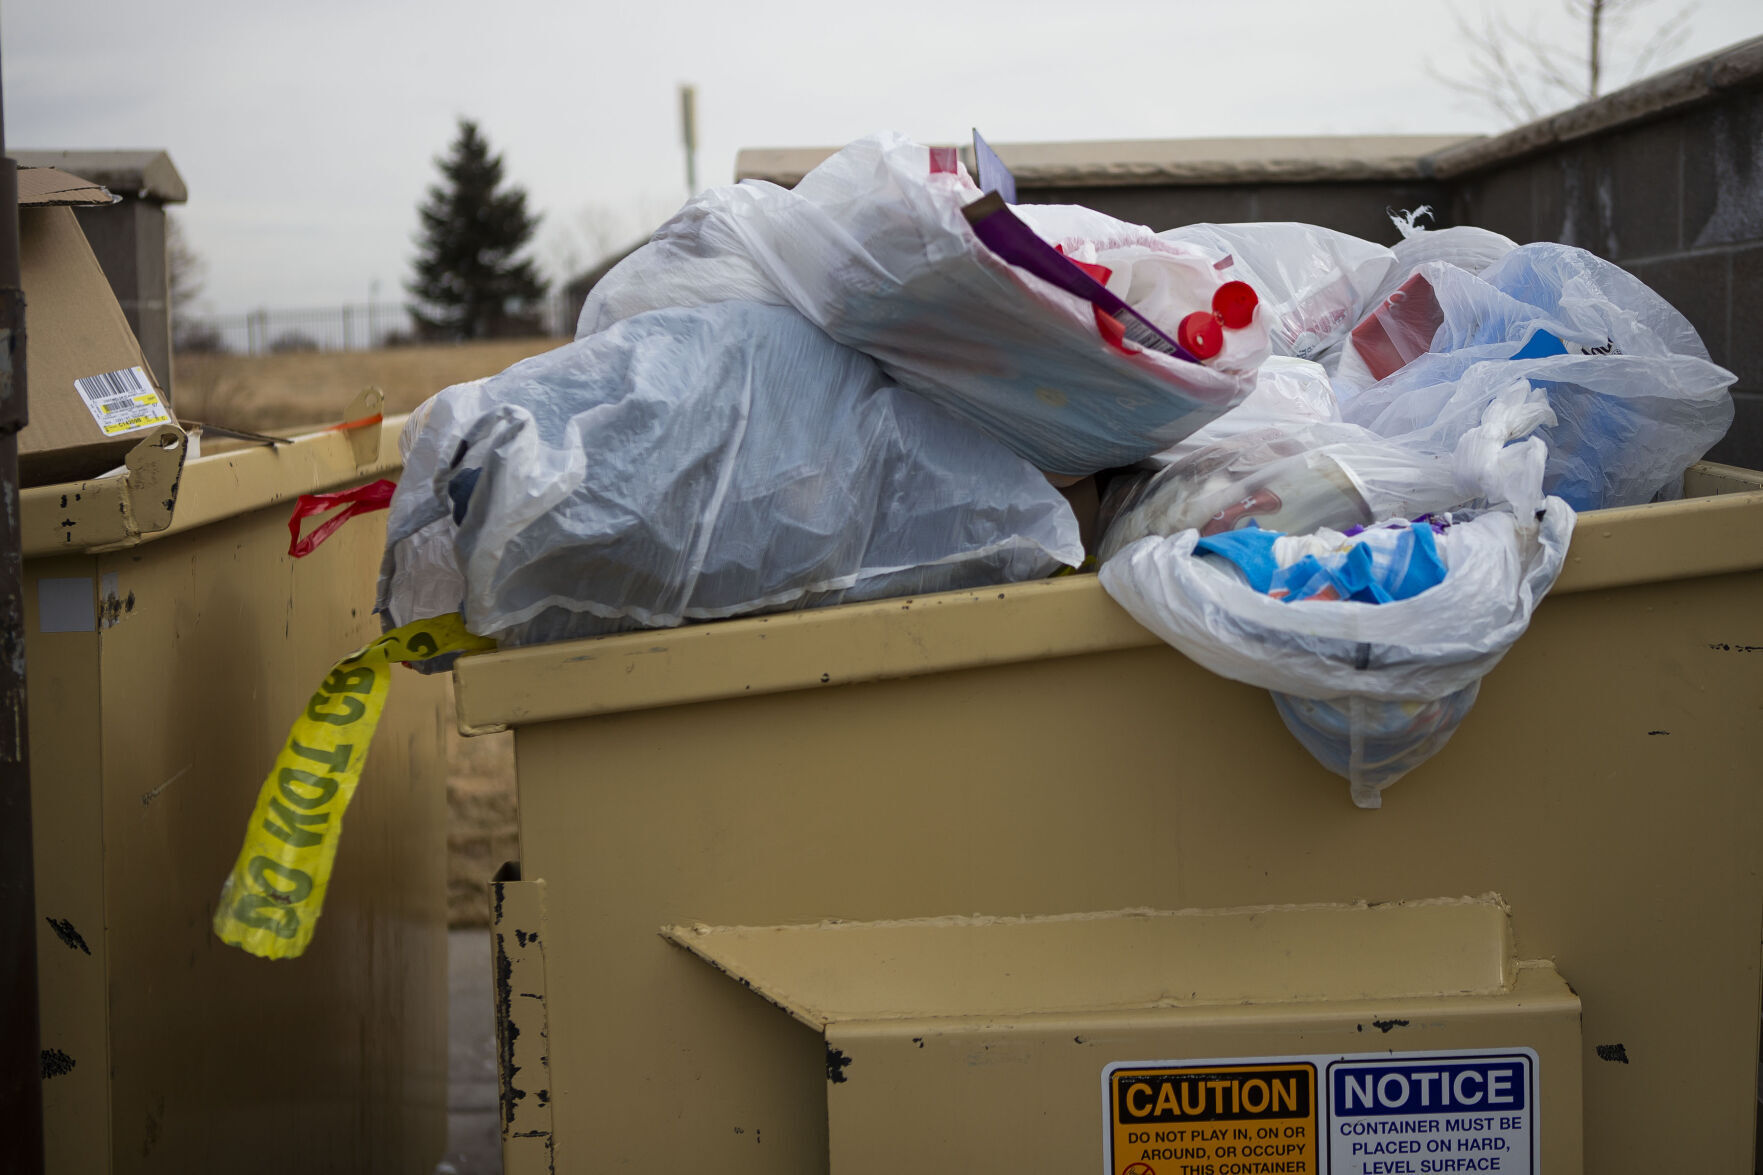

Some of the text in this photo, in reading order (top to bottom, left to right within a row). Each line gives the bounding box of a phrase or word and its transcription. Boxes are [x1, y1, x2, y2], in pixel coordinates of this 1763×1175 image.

[1126, 1078, 1297, 1117] CAUTION
[1344, 1069, 1514, 1110] NOTICE
[1128, 1126, 1305, 1144] DO NOT PLAY IN, ON OR
[1340, 1116, 1522, 1136] CONTAINER MUST BE
[1141, 1144, 1306, 1160] AROUND, OR OCCUPY
[1352, 1137, 1511, 1155] PLACED ON HARD,
[1181, 1161, 1306, 1175] THIS CONTAINER
[1363, 1157, 1500, 1175] LEVEL SURFACE
